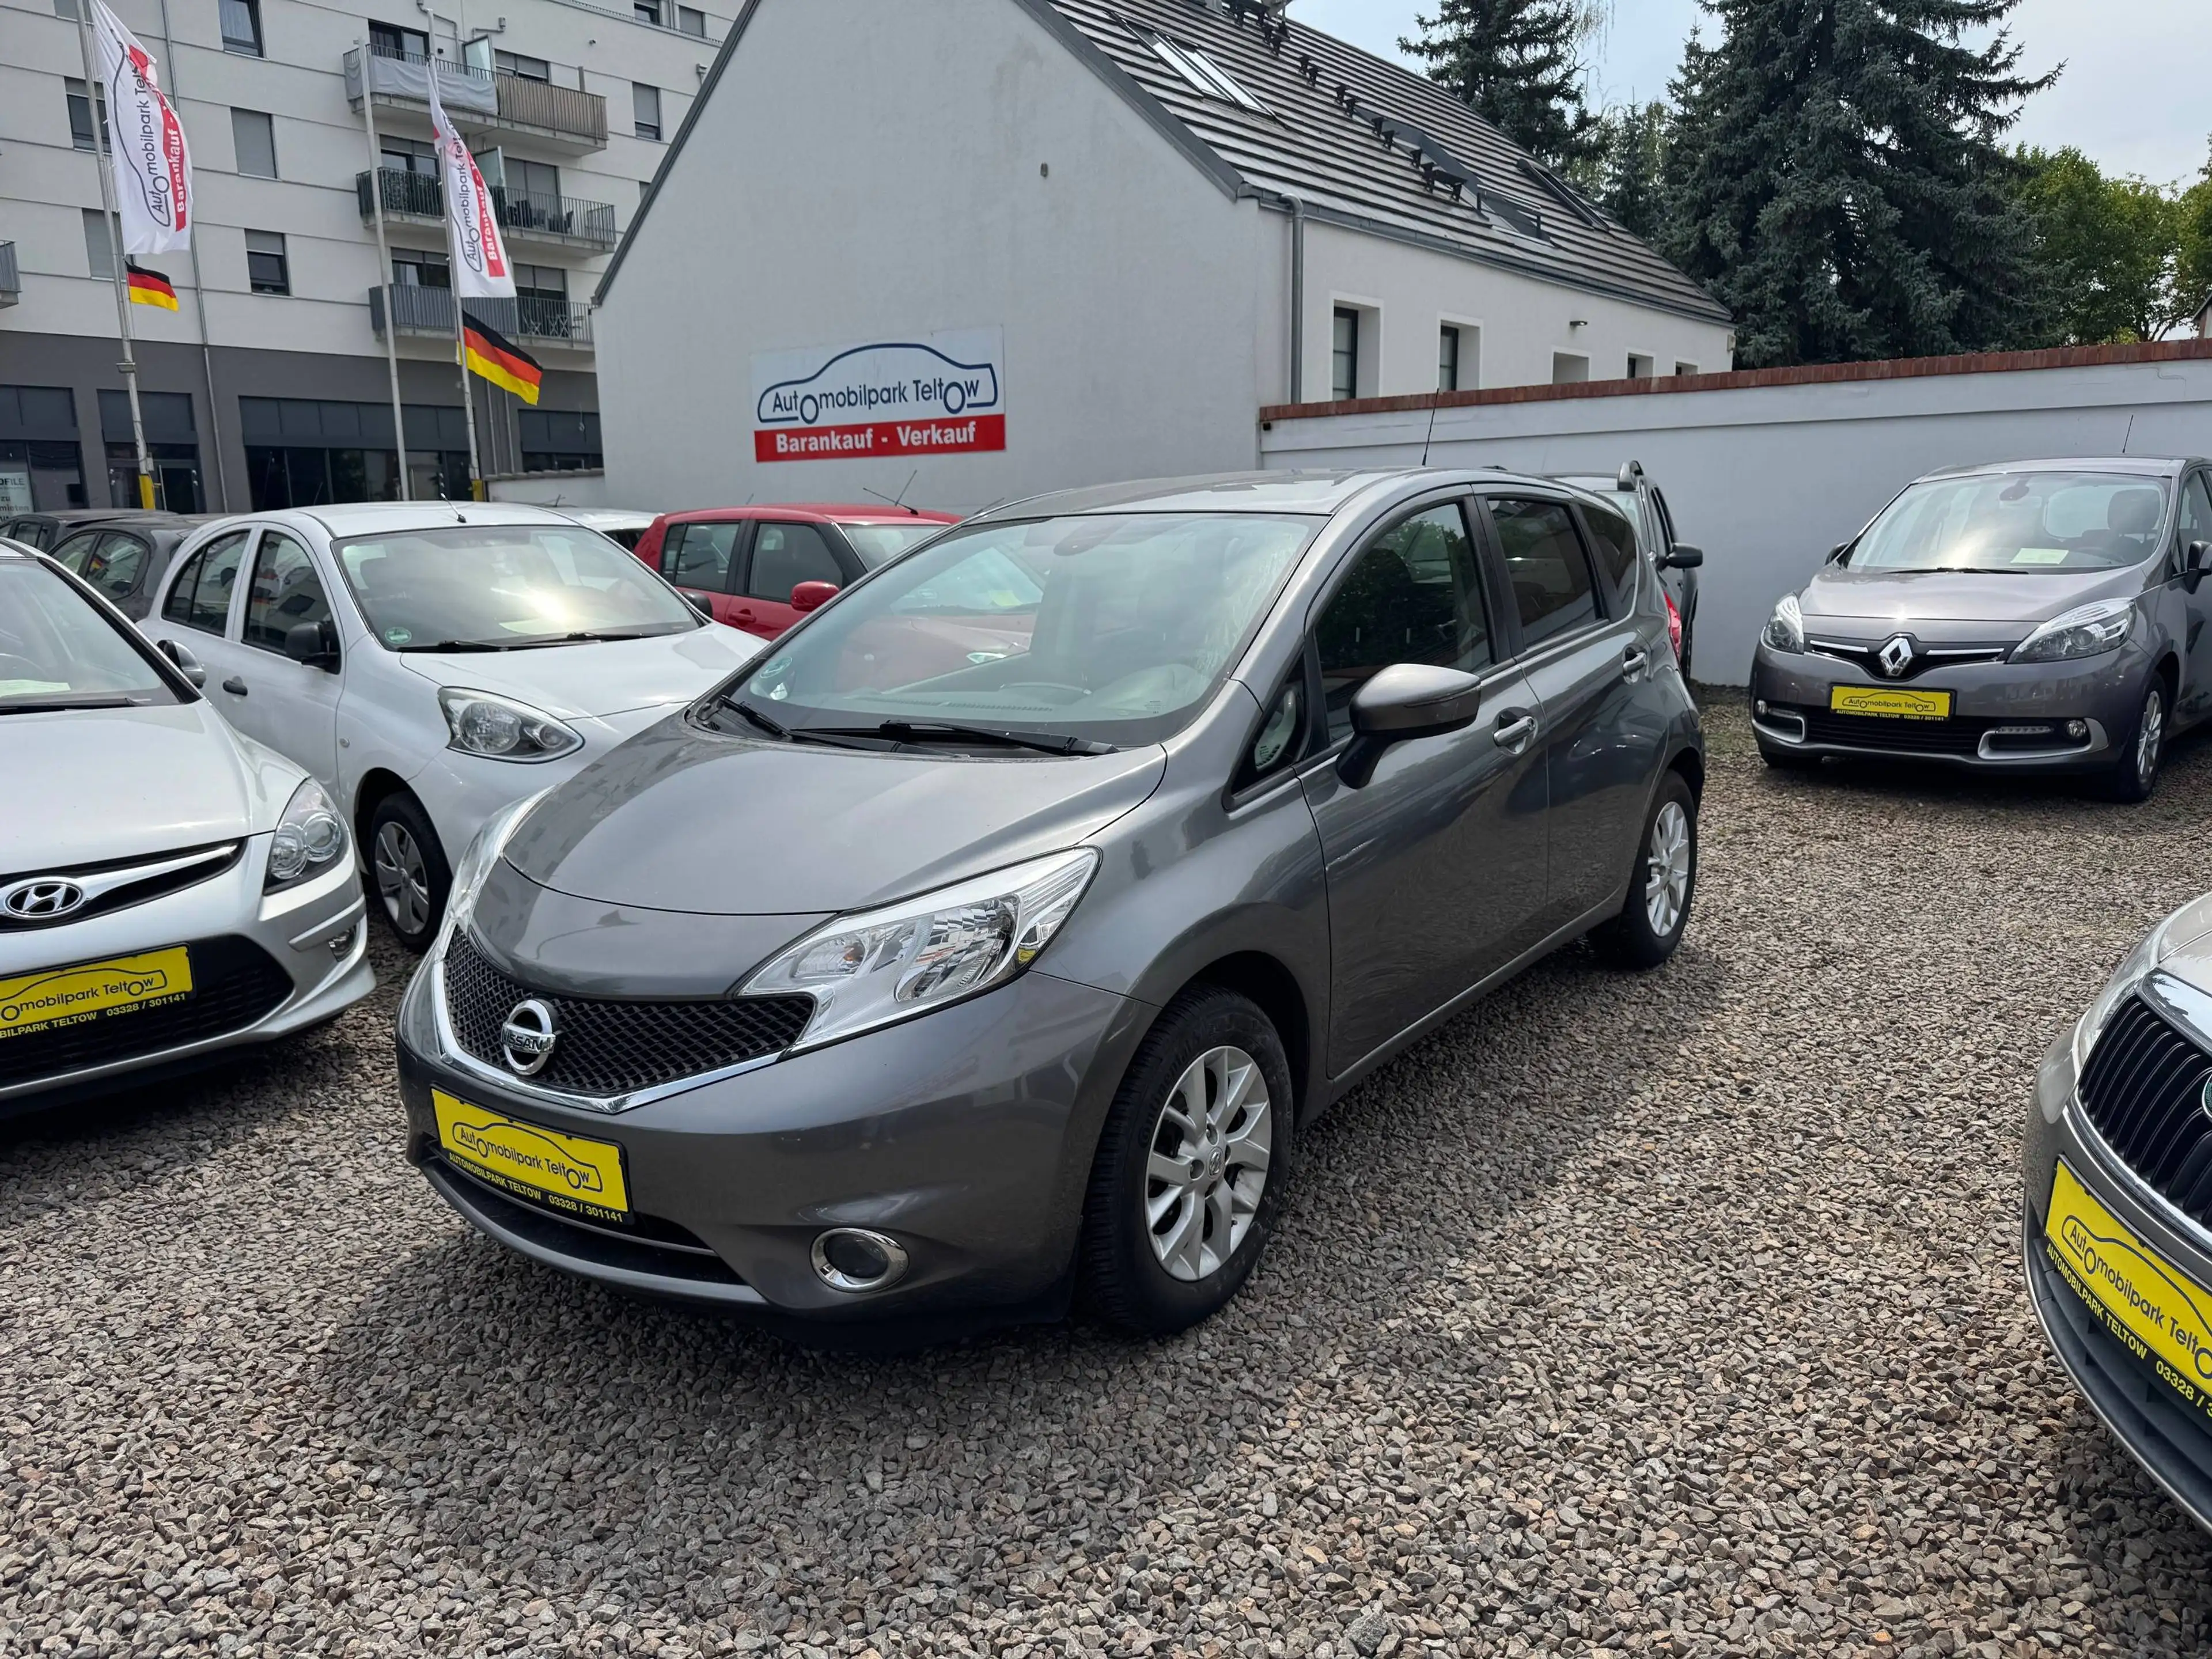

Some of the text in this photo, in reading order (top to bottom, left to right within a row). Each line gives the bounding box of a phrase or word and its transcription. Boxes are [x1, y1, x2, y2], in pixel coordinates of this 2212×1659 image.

[168, 128, 185, 213] Barankauf
[775, 428, 873, 453] Barankauf
[896, 422, 976, 447] Verkauf
[51, 1012, 97, 1028] TELTOW
[106, 1003, 139, 1017] 03328
[149, 993, 186, 1007] 301141
[449, 1153, 508, 1189] AUTOMOBILPARK
[507, 1179, 541, 1200] TELTOW
[548, 1195, 578, 1211] 03328
[585, 1205, 623, 1223] 301141
[2046, 1243, 2104, 1320] AUTOMOBILPARK
[2106, 1312, 2147, 1360] TELTOW
[2156, 1360, 2195, 1400] 03328
